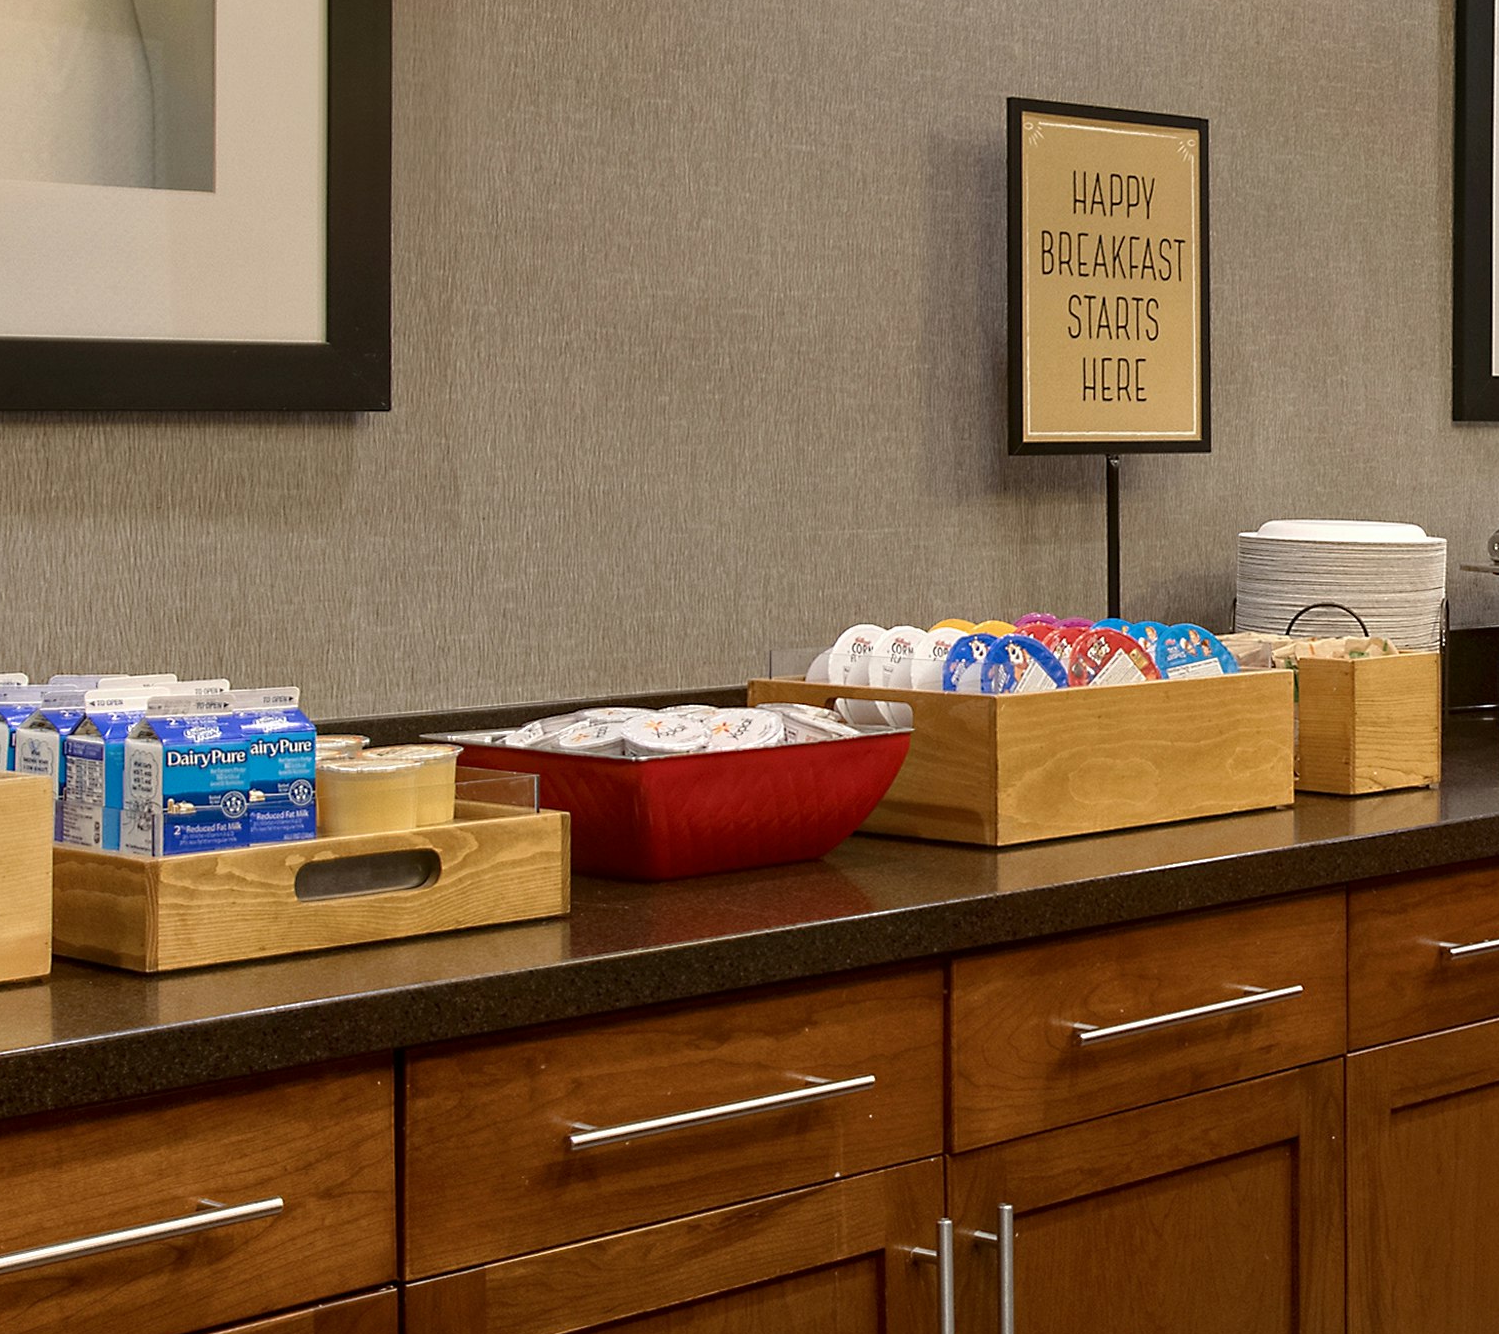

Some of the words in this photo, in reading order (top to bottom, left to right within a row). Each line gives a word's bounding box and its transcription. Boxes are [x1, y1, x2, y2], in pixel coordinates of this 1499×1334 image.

[1073, 170, 1156, 219] HAPPY
[1041, 230, 1186, 282] BREAKFAST
[1067, 294, 1160, 341] STARTS
[1082, 357, 1148, 402] HERE
[932, 646, 949, 658] COR
[250, 739, 312, 757] airyPure
[167, 749, 246, 767] DairyPure
[256, 811, 284, 820] Reduced
[285, 810, 295, 819] Fat
[296, 809, 309, 818] Milk
[186, 823, 215, 834] Reduced
[216, 823, 227, 832] Fat
[228, 821, 242, 831] Milk
